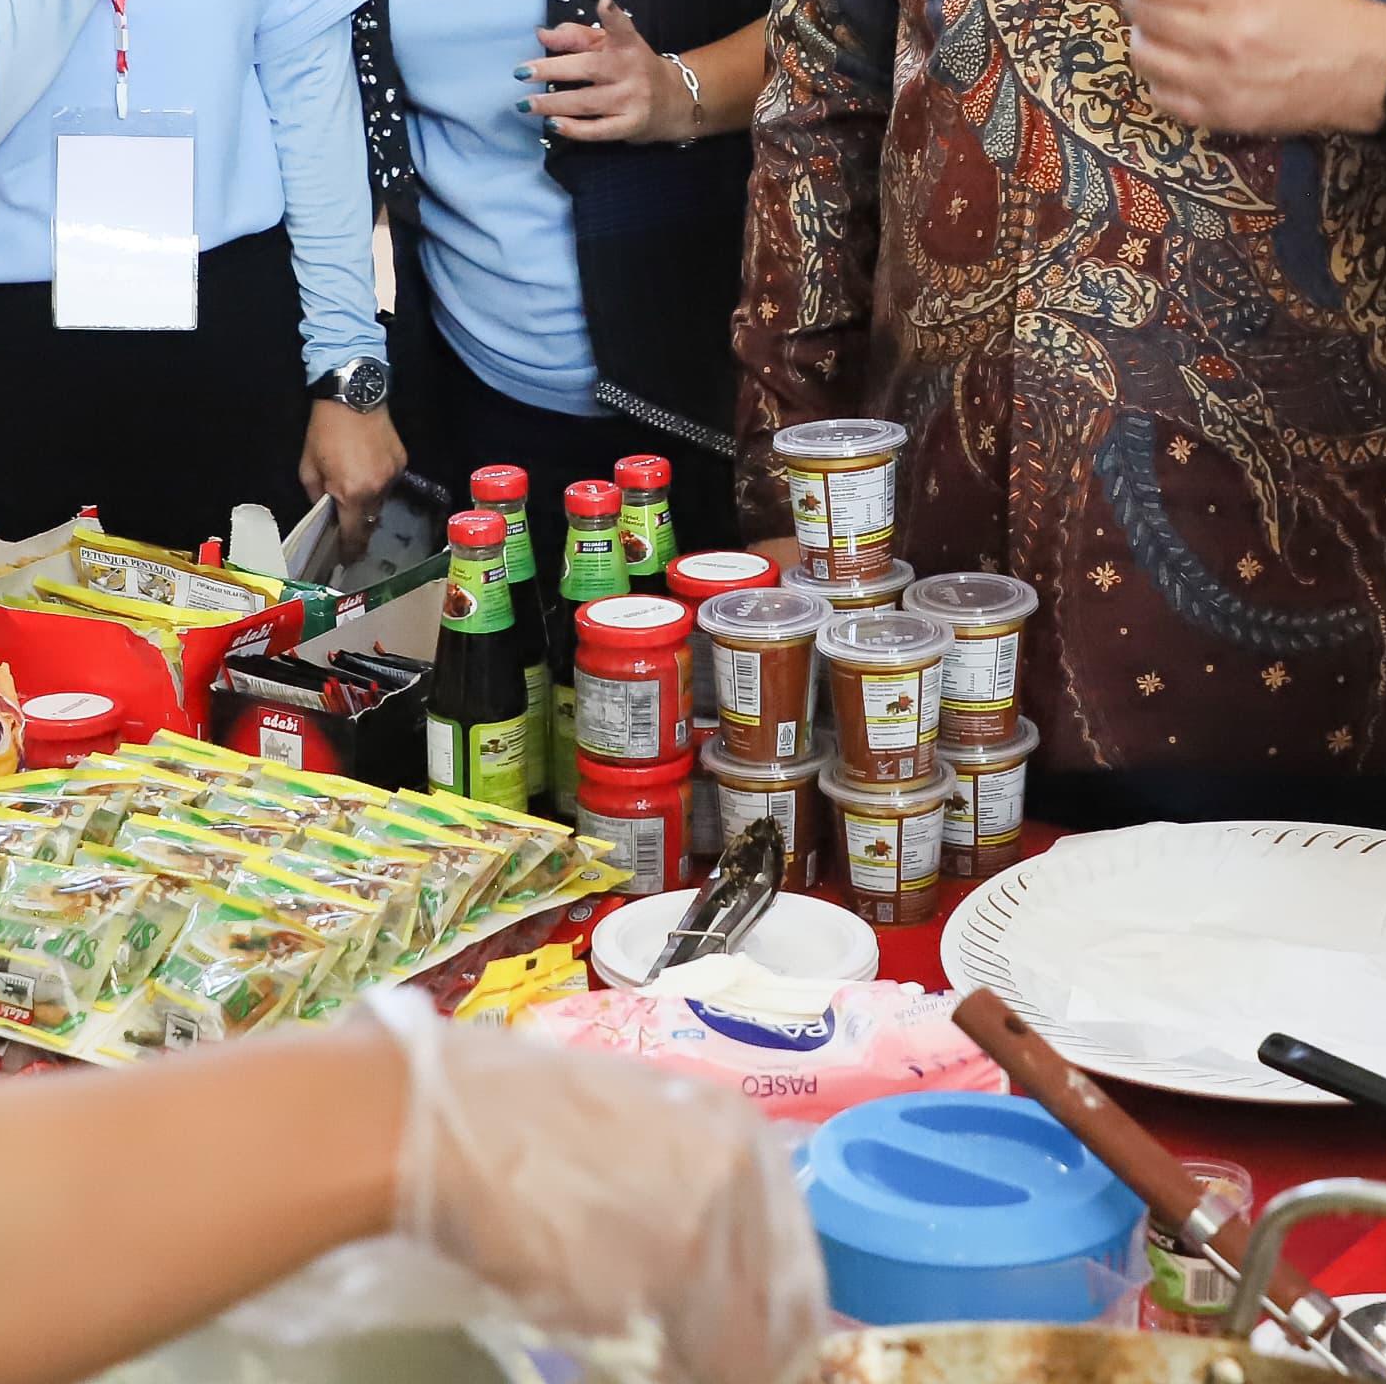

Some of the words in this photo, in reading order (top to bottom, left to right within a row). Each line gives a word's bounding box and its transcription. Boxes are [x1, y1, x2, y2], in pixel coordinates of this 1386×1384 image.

[81, 548, 128, 566] PETUNJUK
[130, 558, 177, 579] PENYAJIAN
[337, 594, 364, 613] adabi
[232, 623, 274, 648] adabi
[262, 713, 298, 733] adabi
[0, 1003, 31, 1021] adabi
[741, 1074, 817, 1097] PASEO
